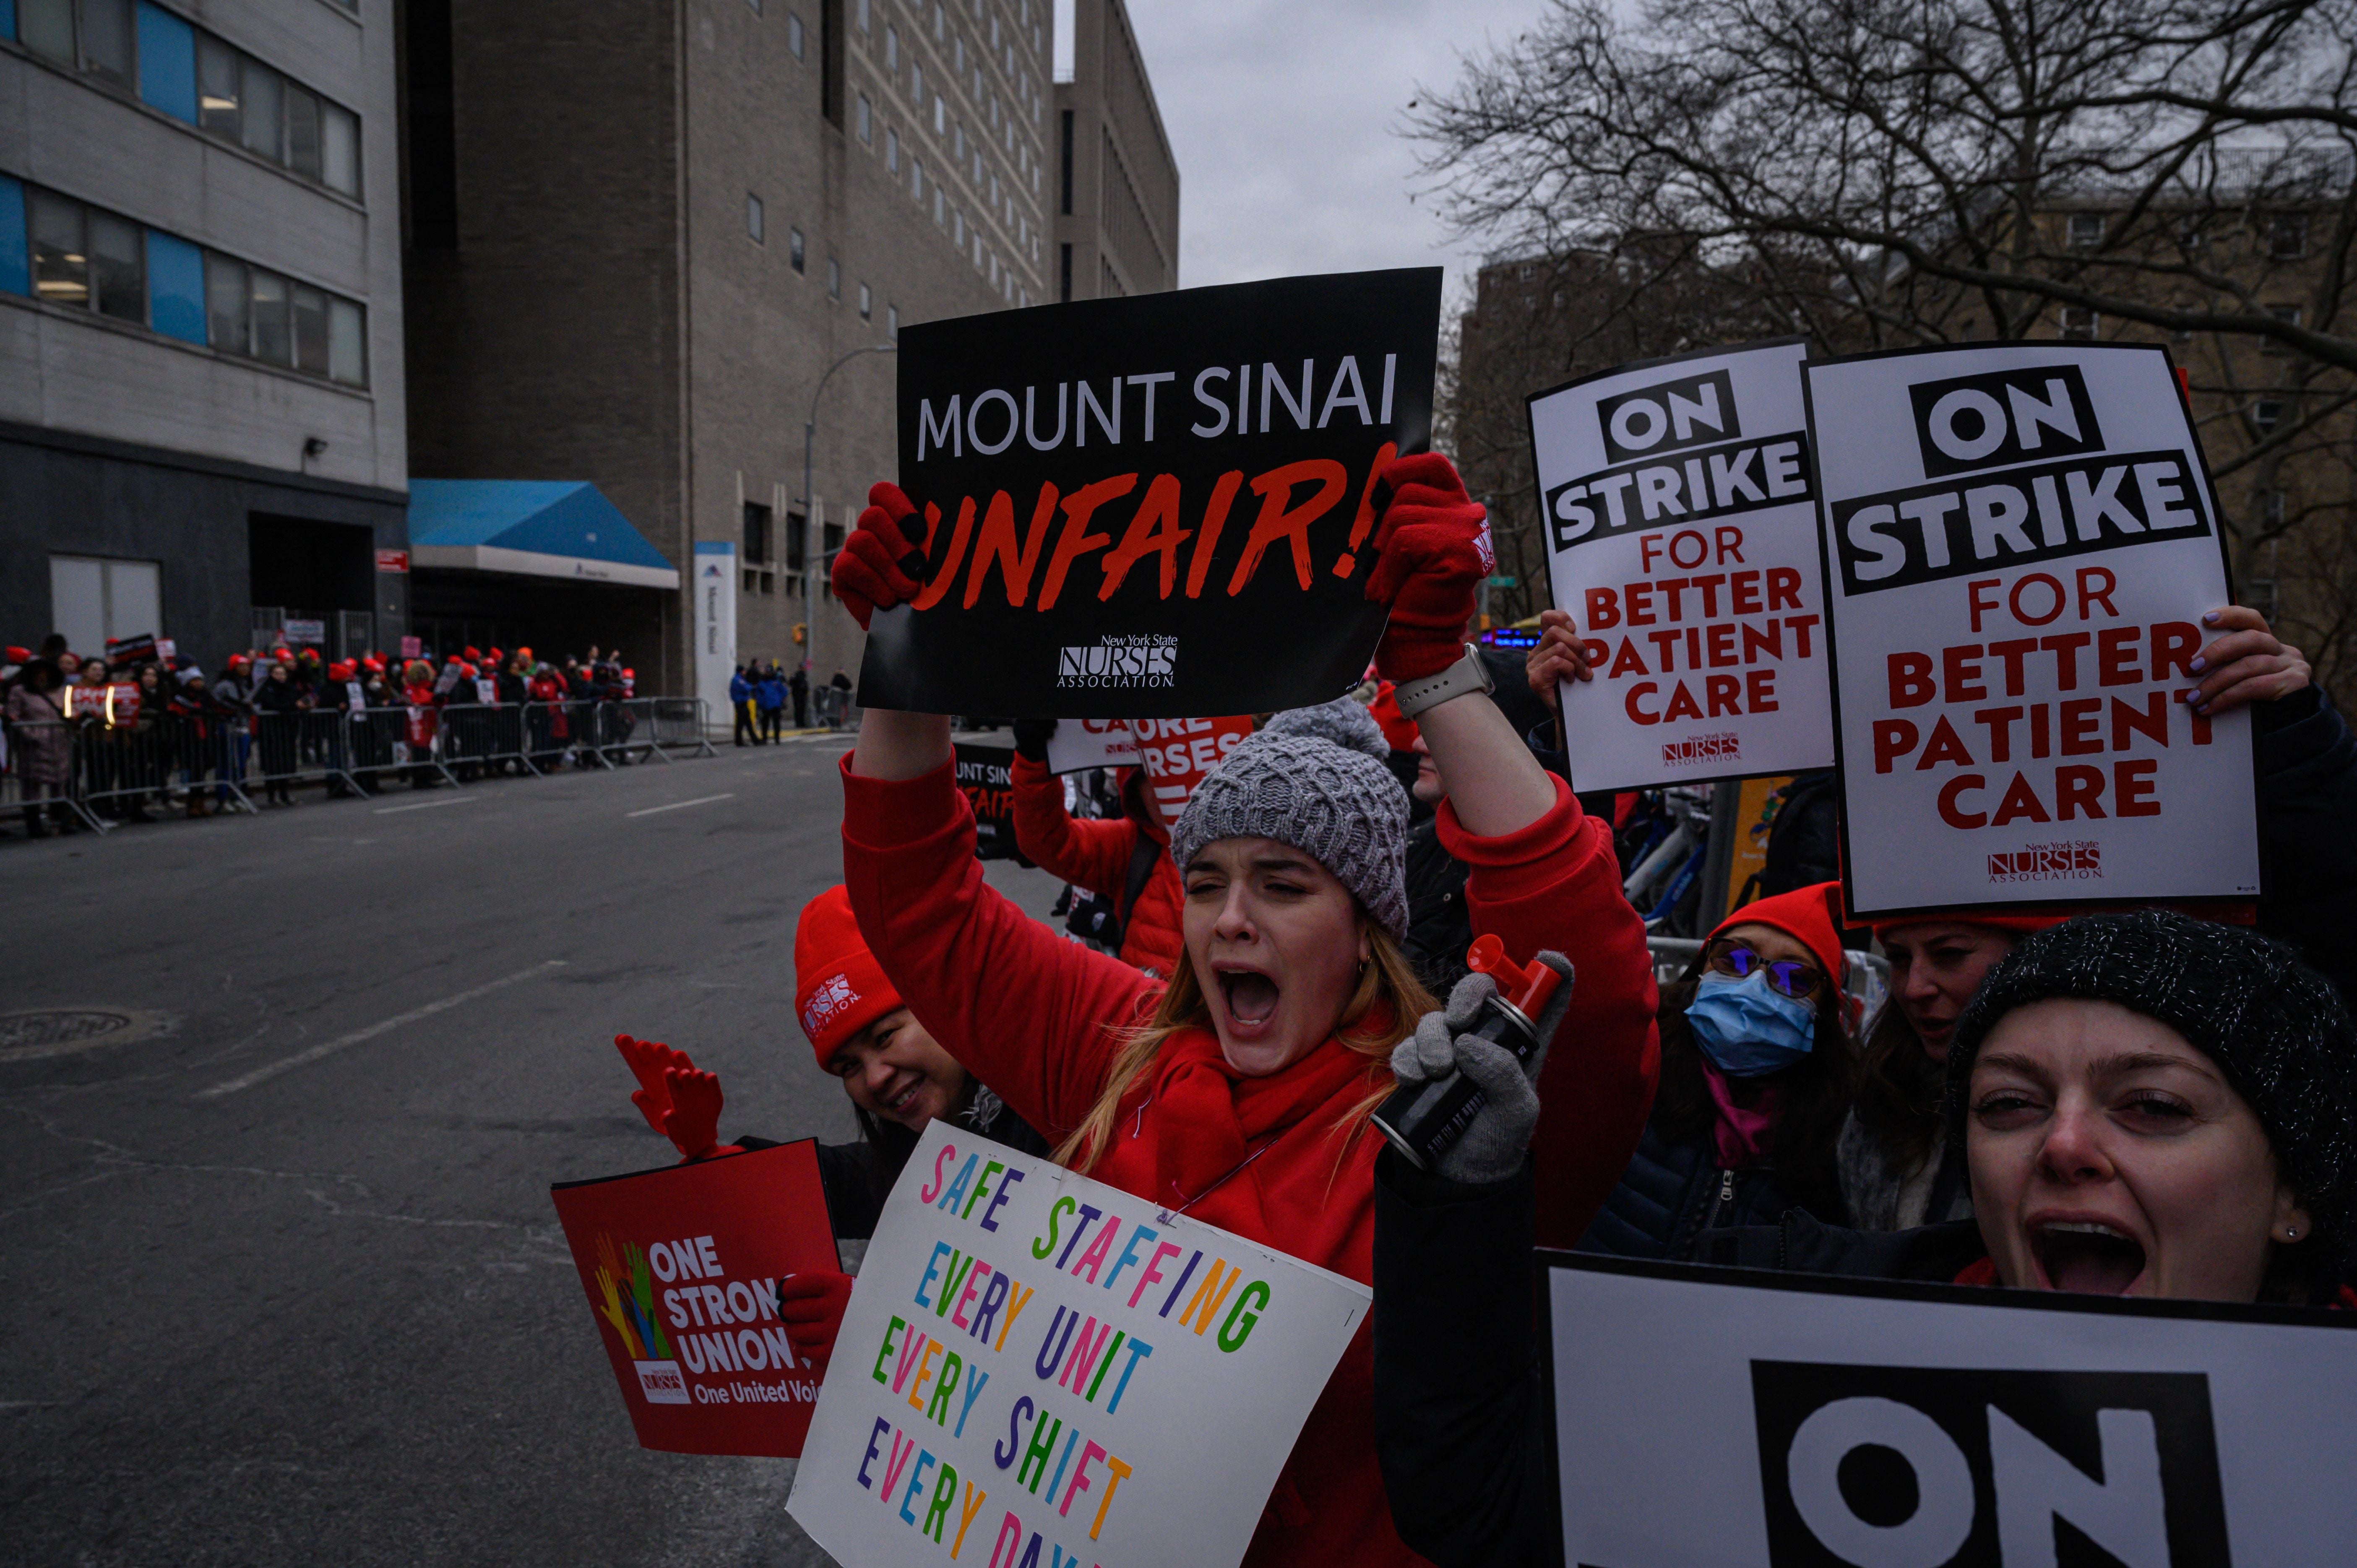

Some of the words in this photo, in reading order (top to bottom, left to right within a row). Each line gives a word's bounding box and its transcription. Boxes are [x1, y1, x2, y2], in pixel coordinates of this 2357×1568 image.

[917, 371, 1175, 462] MOUNT
[1190, 353, 1397, 439] SINAI
[1610, 382, 1724, 451] ON
[1928, 378, 2083, 461] ON
[1555, 439, 1807, 541] STRIKE
[909, 440, 1399, 612] UNFAIR!
[1845, 460, 2197, 582] STRIKE
[1640, 526, 1744, 573] FOR
[1585, 567, 1804, 631] BETTER
[1968, 566, 2119, 633] FOR
[1058, 646, 1177, 676] NURSES
[1101, 634, 1126, 646] New
[1128, 633, 1151, 646] York
[1152, 634, 1178, 646] State
[1582, 614, 1820, 680] PATIENT
[1887, 621, 2204, 710] BETTER
[1057, 675, 1175, 688] ASSOCIATION
[1625, 670, 1779, 725] CARE
[1082, 719, 1129, 733] CA
[1133, 718, 1213, 741] ORE
[1662, 738, 1740, 761] NURSES
[1872, 688, 2213, 775] PATIENT
[956, 761, 985, 782] UNT
[987, 764, 1012, 786] SIN
[1143, 732, 1241, 778] RSES
[1663, 754, 1742, 768] ASSOCIATION
[1937, 758, 2162, 830] CARE
[1988, 848, 2101, 875] NURSES
[2026, 843, 2049, 852] New
[2051, 840, 2073, 850] York
[2075, 840, 2099, 849] State
[1989, 870, 2102, 884] ASSOCIATION
[802, 978, 853, 1031] URSES
[649, 1235, 724, 1283] ONE
[922, 1144, 1025, 1233] SAFE
[1031, 1196, 1271, 1353] STAFFING
[663, 1274, 796, 1329] STRON
[914, 1240, 1035, 1352] EVERY
[1035, 1305, 1154, 1415] UNIT
[694, 1383, 731, 1404] One
[730, 1379, 790, 1403] United
[789, 1379, 821, 1402] Voi
[871, 1315, 990, 1440] EVERY
[994, 1395, 1133, 1542] SHIFT
[856, 1415, 987, 1561] EVERY
[1786, 1394, 2173, 1568] ON
